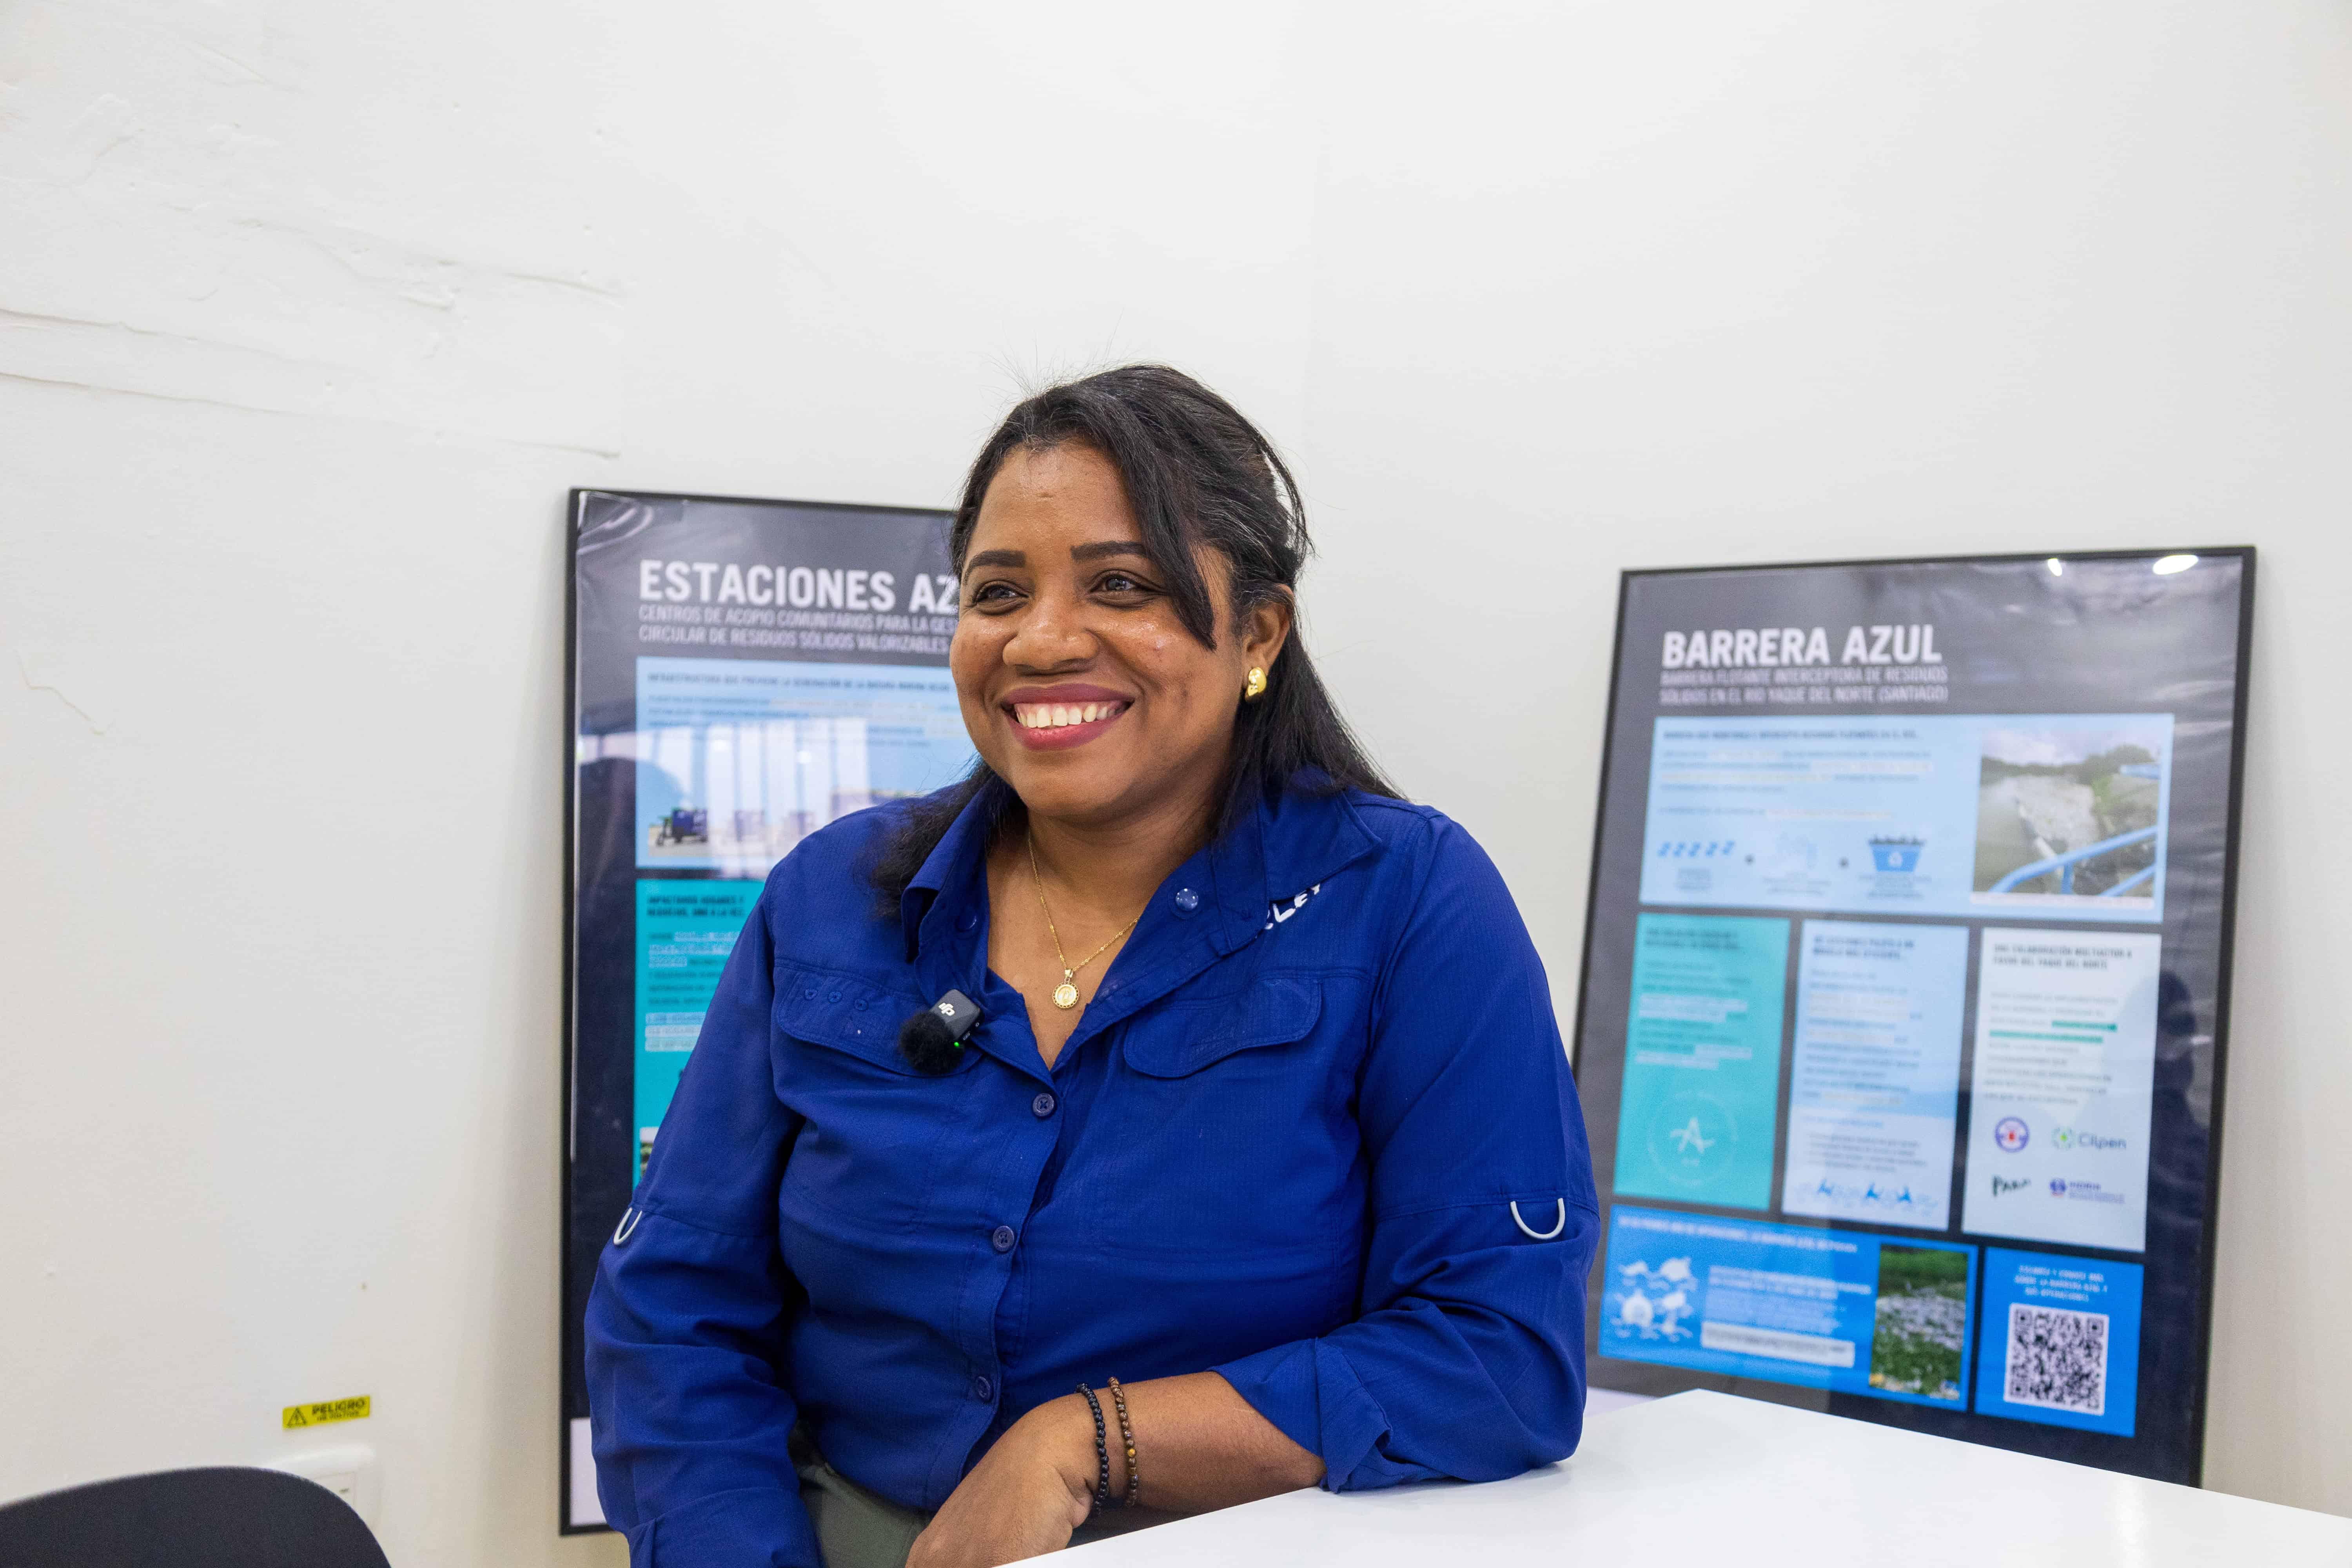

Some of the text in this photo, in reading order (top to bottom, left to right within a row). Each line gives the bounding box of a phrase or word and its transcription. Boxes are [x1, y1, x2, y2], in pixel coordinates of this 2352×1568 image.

[639, 559, 960, 614] ESTACIONES AZ
[1662, 624, 1943, 669] BARRERA AZUL
[312, 1397, 365, 1416] PELIGRO
